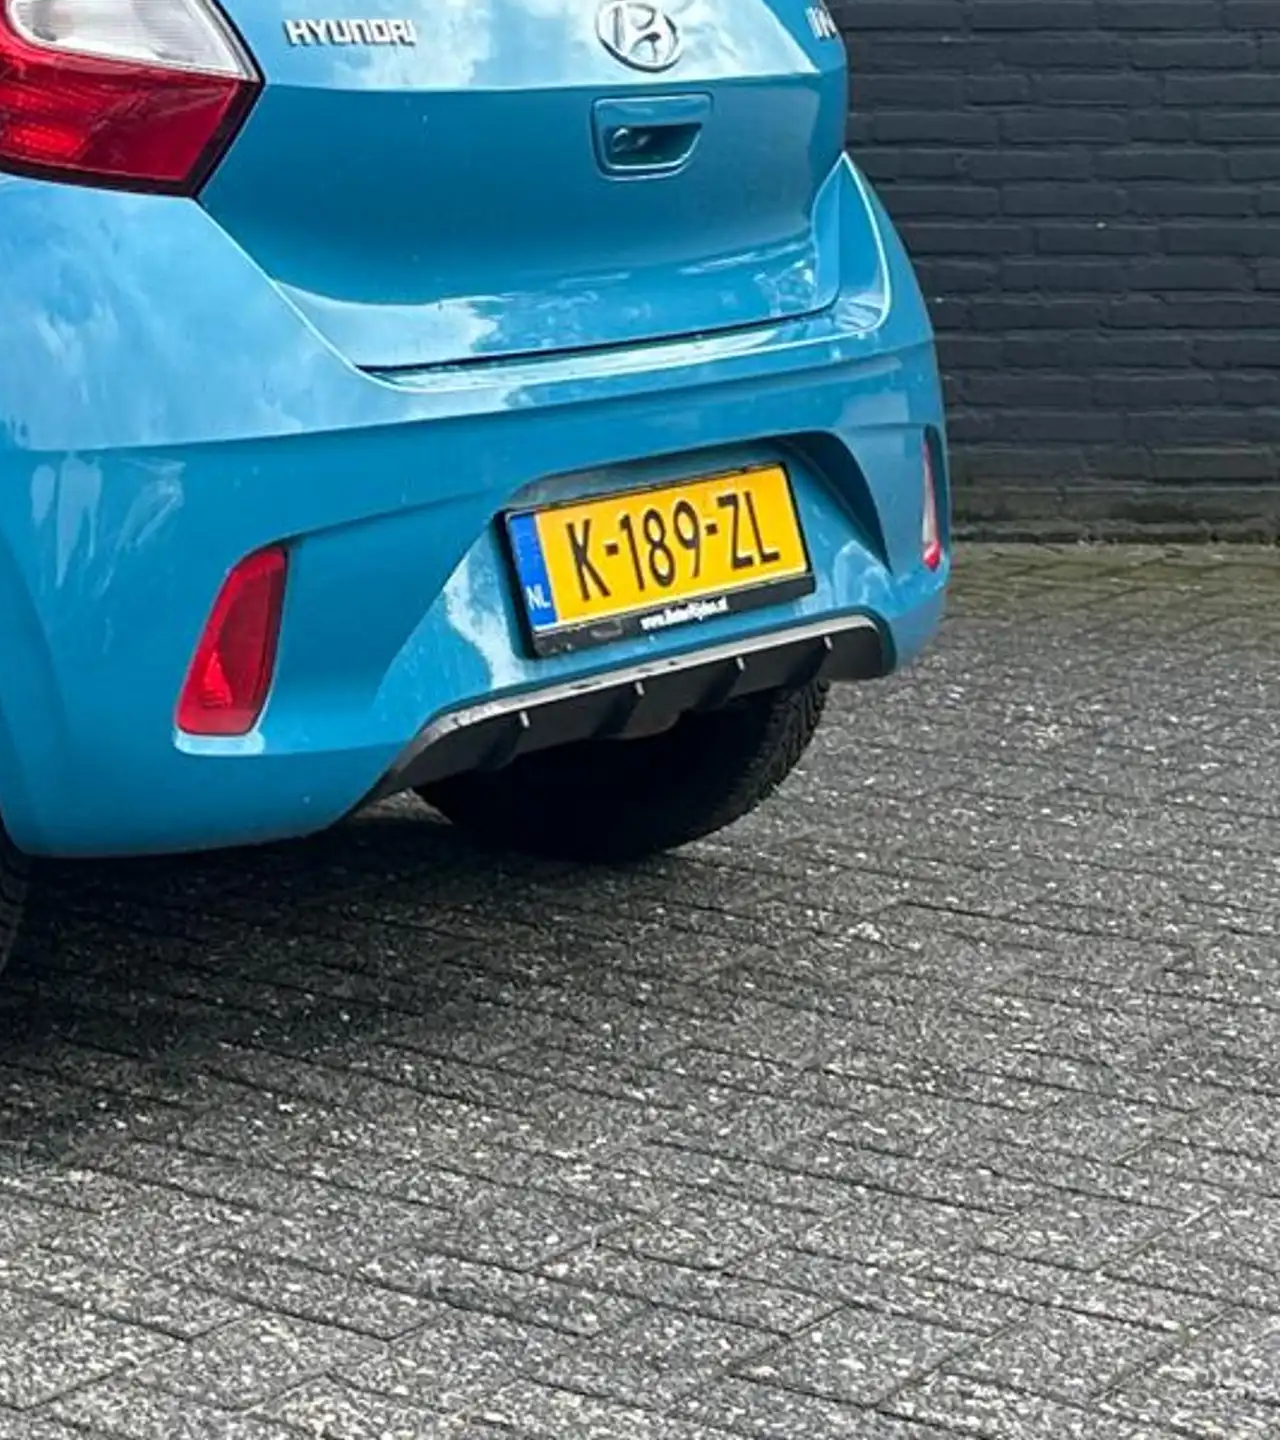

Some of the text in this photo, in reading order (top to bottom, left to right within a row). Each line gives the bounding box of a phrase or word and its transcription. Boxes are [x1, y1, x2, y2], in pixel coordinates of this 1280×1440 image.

[284, 18, 418, 47] HYUNDAI
[565, 490, 781, 603] K-189-ZL
[526, 584, 552, 611] NL
